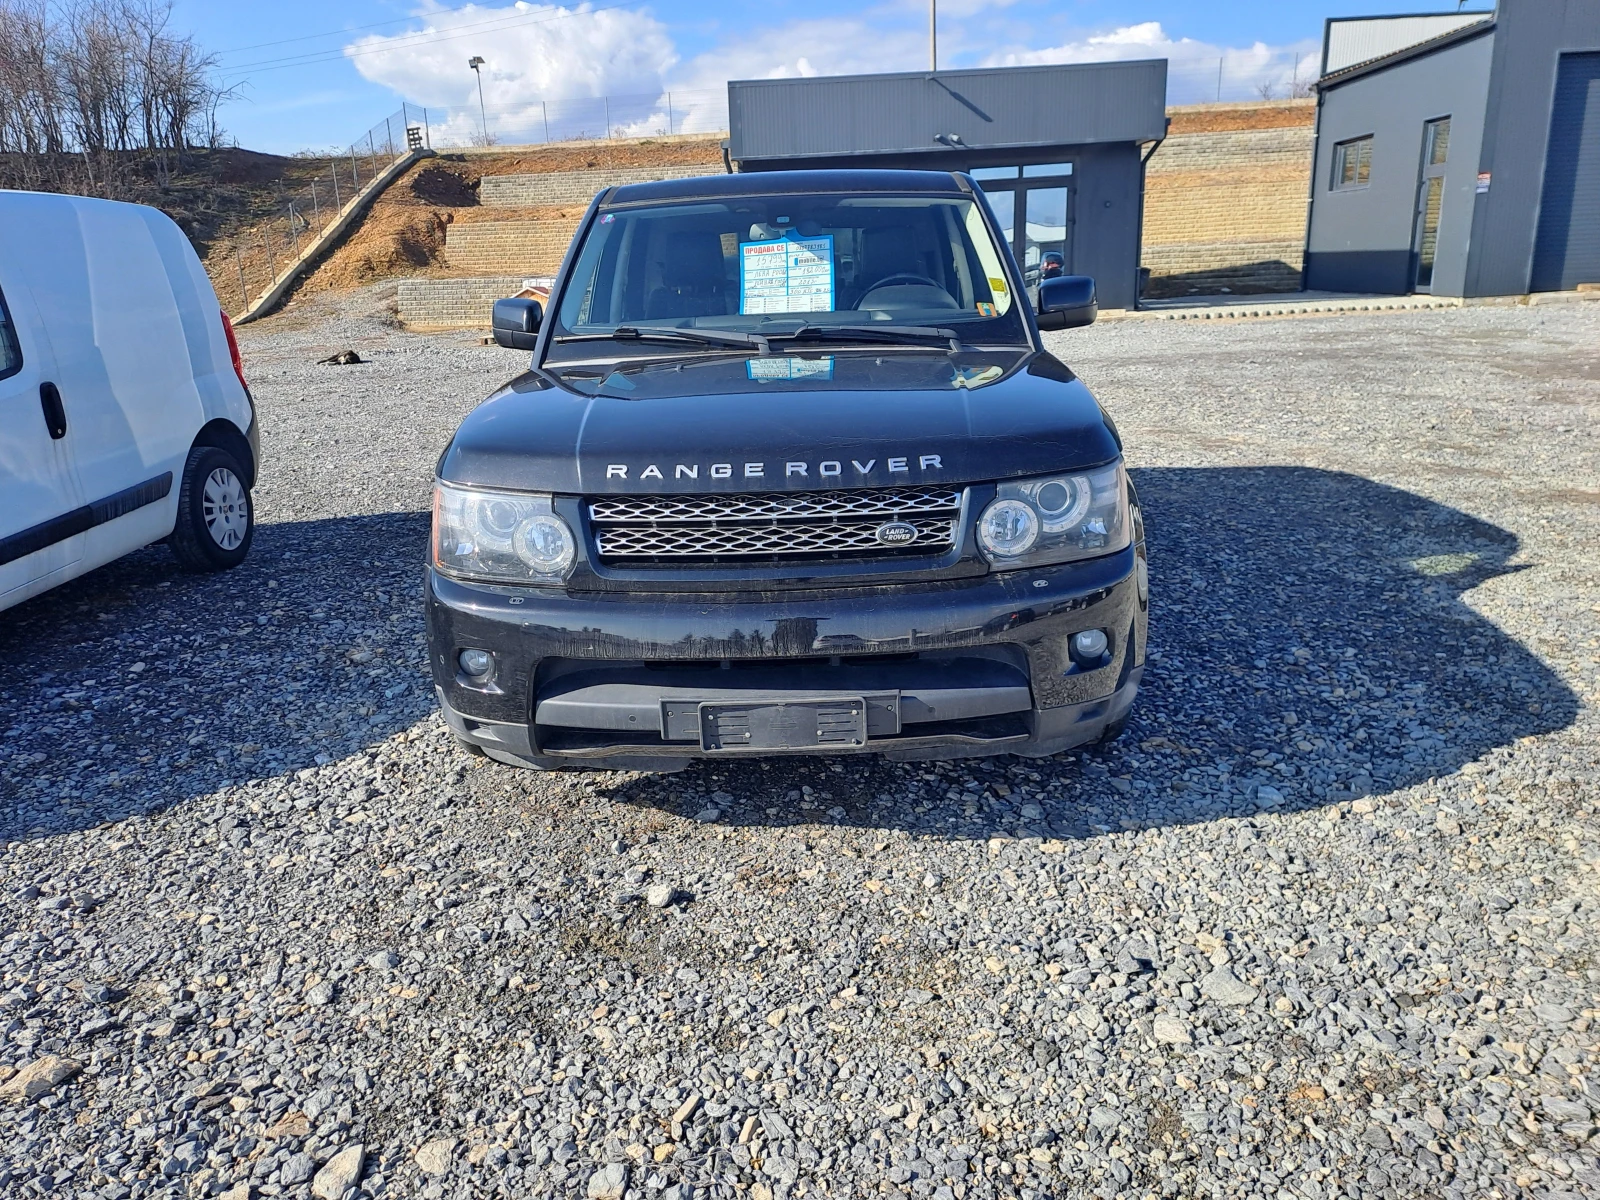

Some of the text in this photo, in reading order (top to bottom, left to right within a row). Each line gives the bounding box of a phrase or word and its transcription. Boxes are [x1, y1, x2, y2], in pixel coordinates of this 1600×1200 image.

[745, 245, 775, 255] ПРОДАВА
[776, 244, 785, 252] СЕ
[606, 454, 943, 479] RANGE ROVER
[887, 533, 911, 541] ROVER
